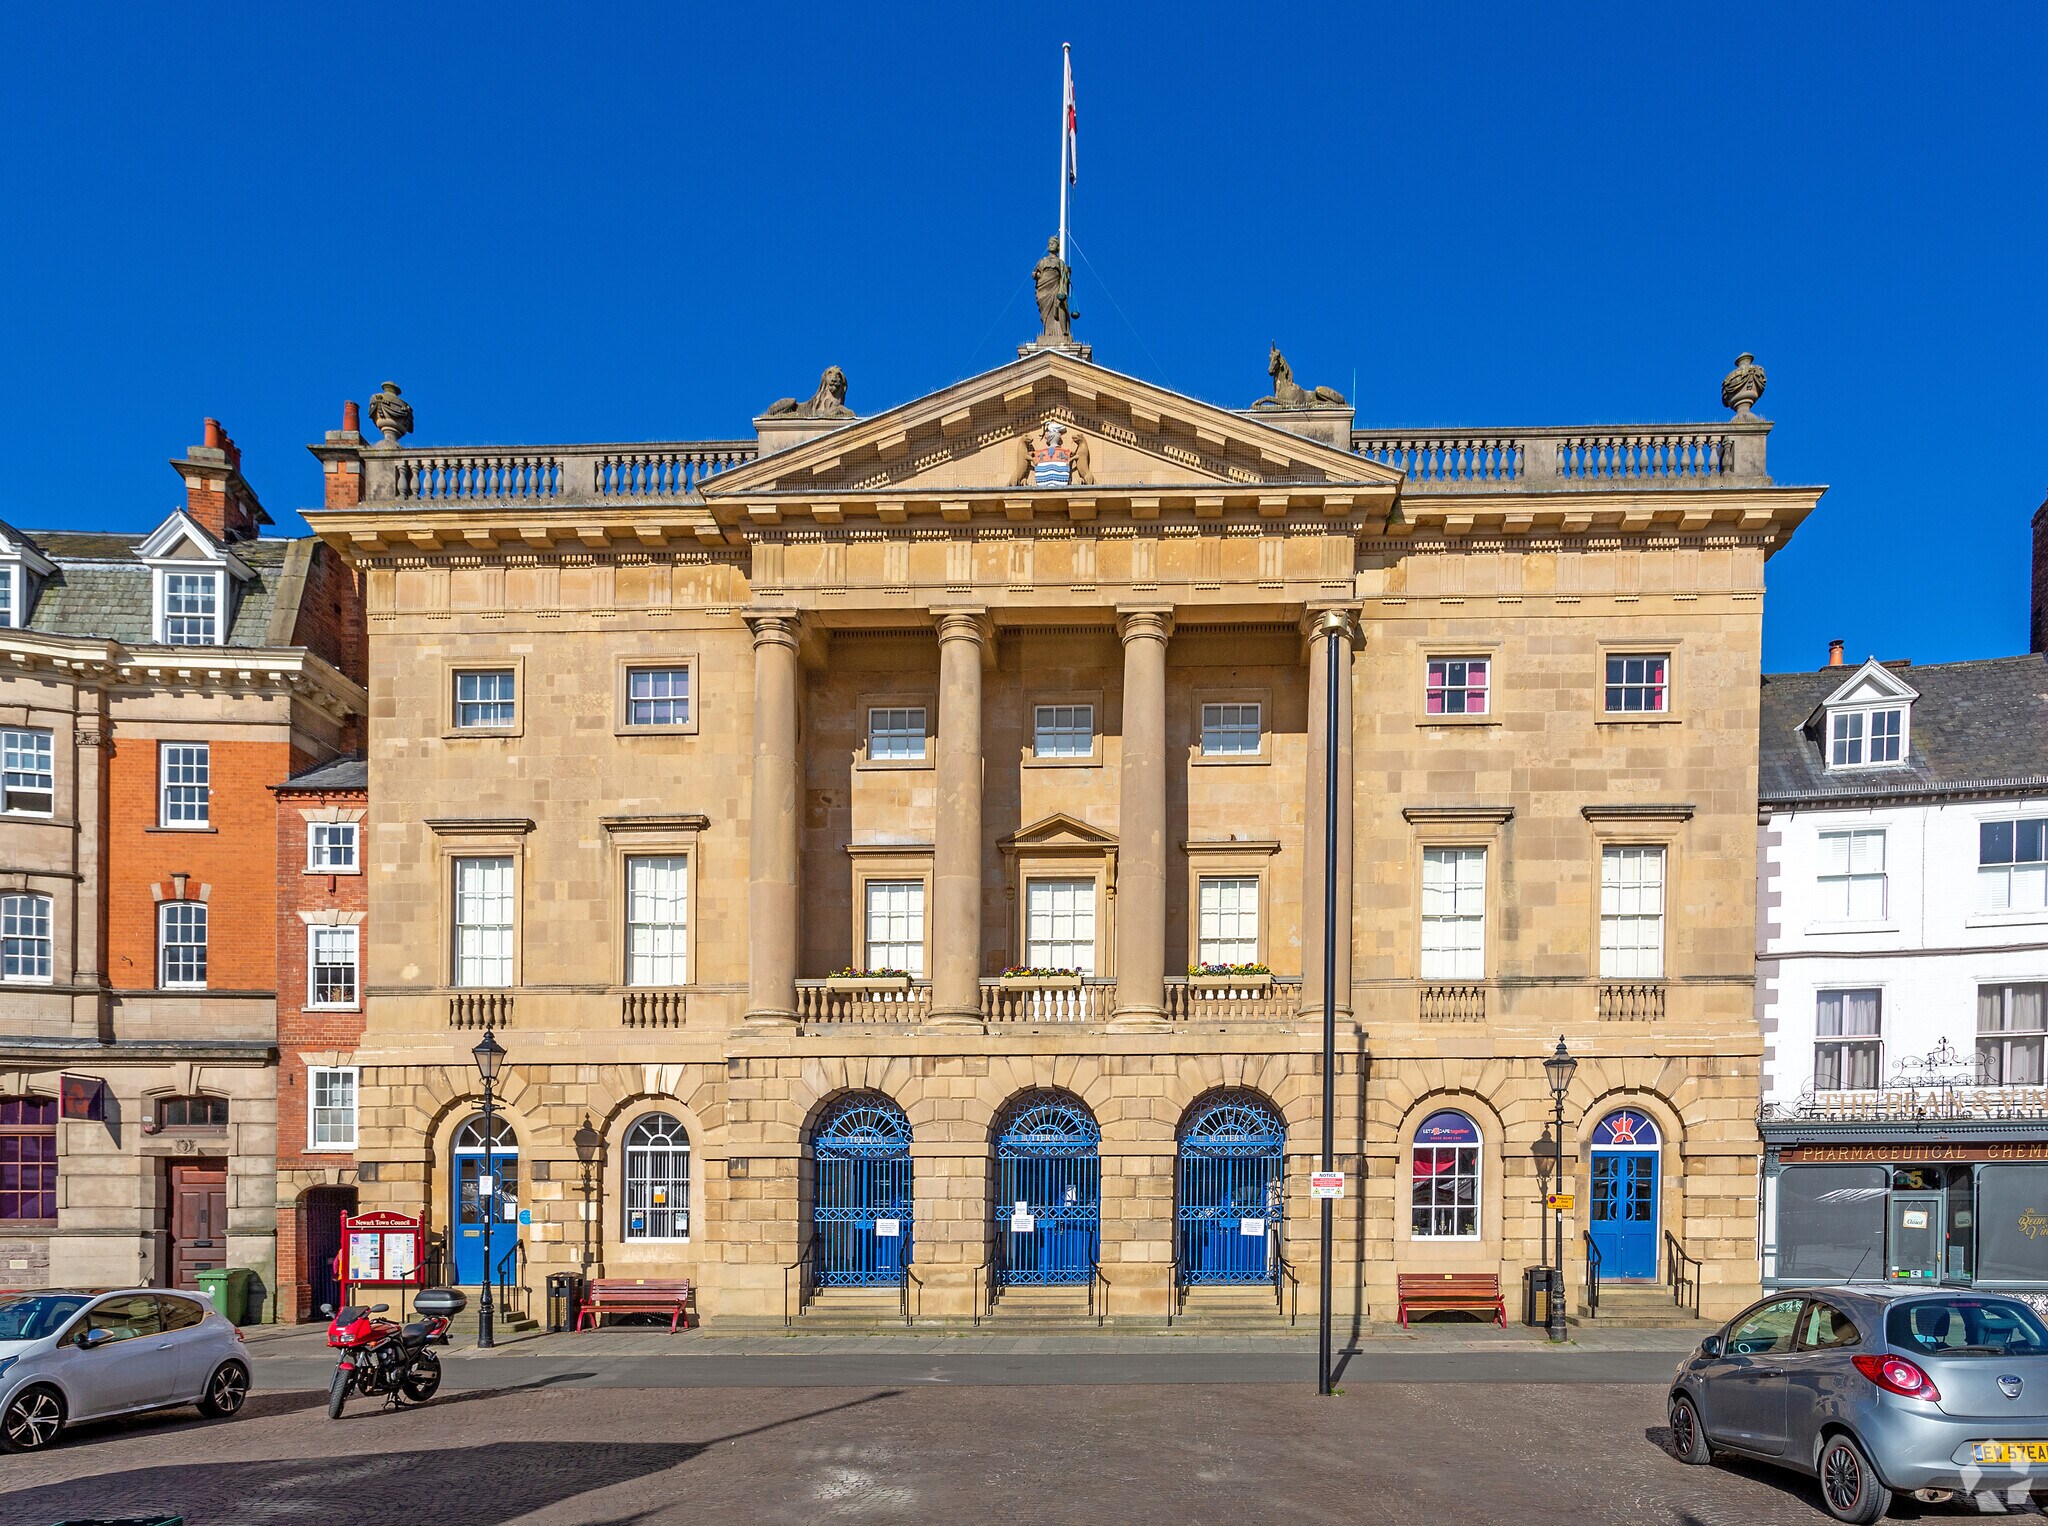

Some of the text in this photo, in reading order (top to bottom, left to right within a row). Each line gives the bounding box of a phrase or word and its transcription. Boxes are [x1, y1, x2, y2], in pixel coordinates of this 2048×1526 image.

[1820, 1093, 1876, 1115] THE
[1885, 1091, 1964, 1114] BEAN
[1971, 1090, 1993, 1112] &
[1802, 1145, 1967, 1160] PHARMACEUTICAL
[1910, 1170, 1922, 1189] 5
[2008, 1445, 2048, 1460] 57EA
